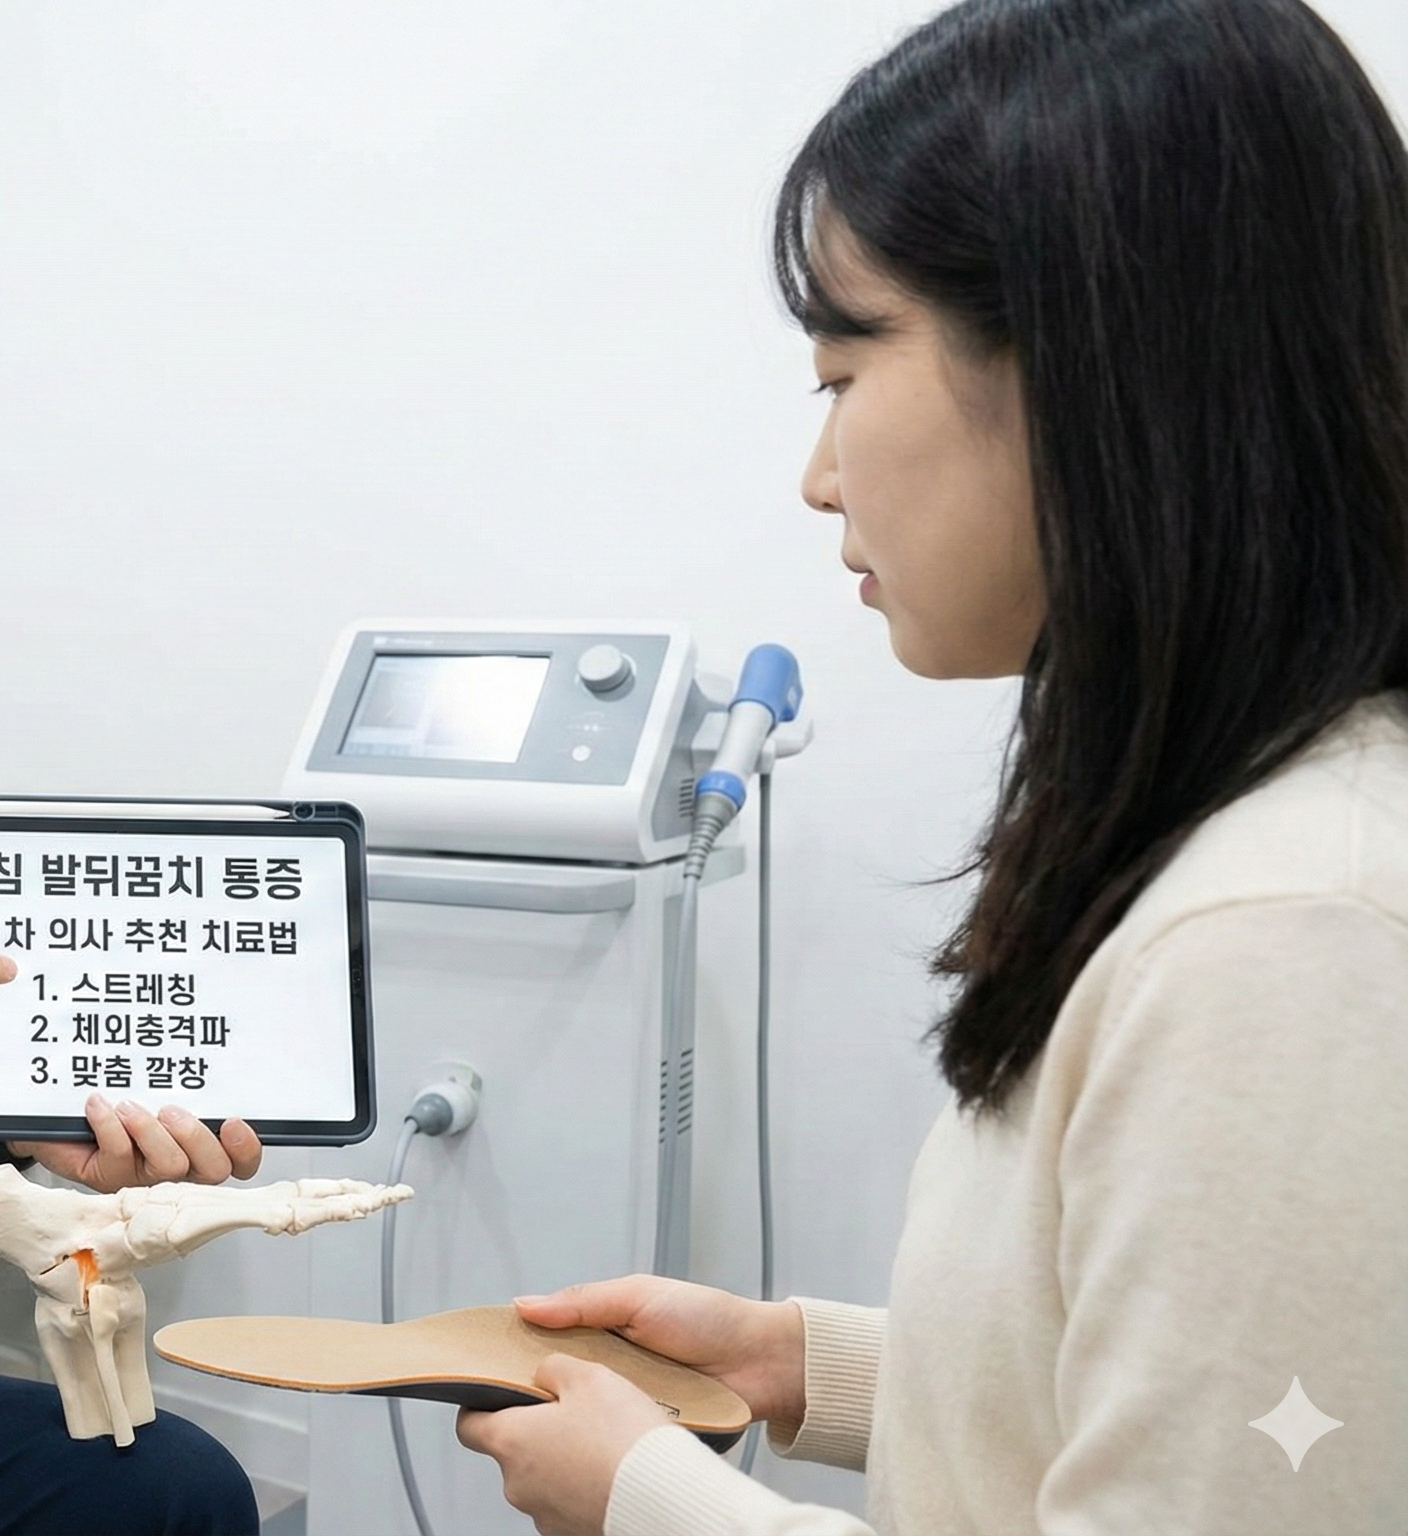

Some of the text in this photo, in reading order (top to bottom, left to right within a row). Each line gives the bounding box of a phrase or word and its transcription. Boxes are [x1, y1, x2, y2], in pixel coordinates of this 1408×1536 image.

[41, 854, 204, 898] 발뒤꿈치
[222, 857, 303, 900] 통증
[48, 918, 114, 951] 의사
[124, 918, 187, 953] 추천
[202, 919, 297, 954] 치료법
[32, 973, 195, 1006] 1. 스트레칭
[30, 1013, 231, 1047] 2. 체외충격파
[30, 1055, 209, 1090] 3. 맞춤 깔창
